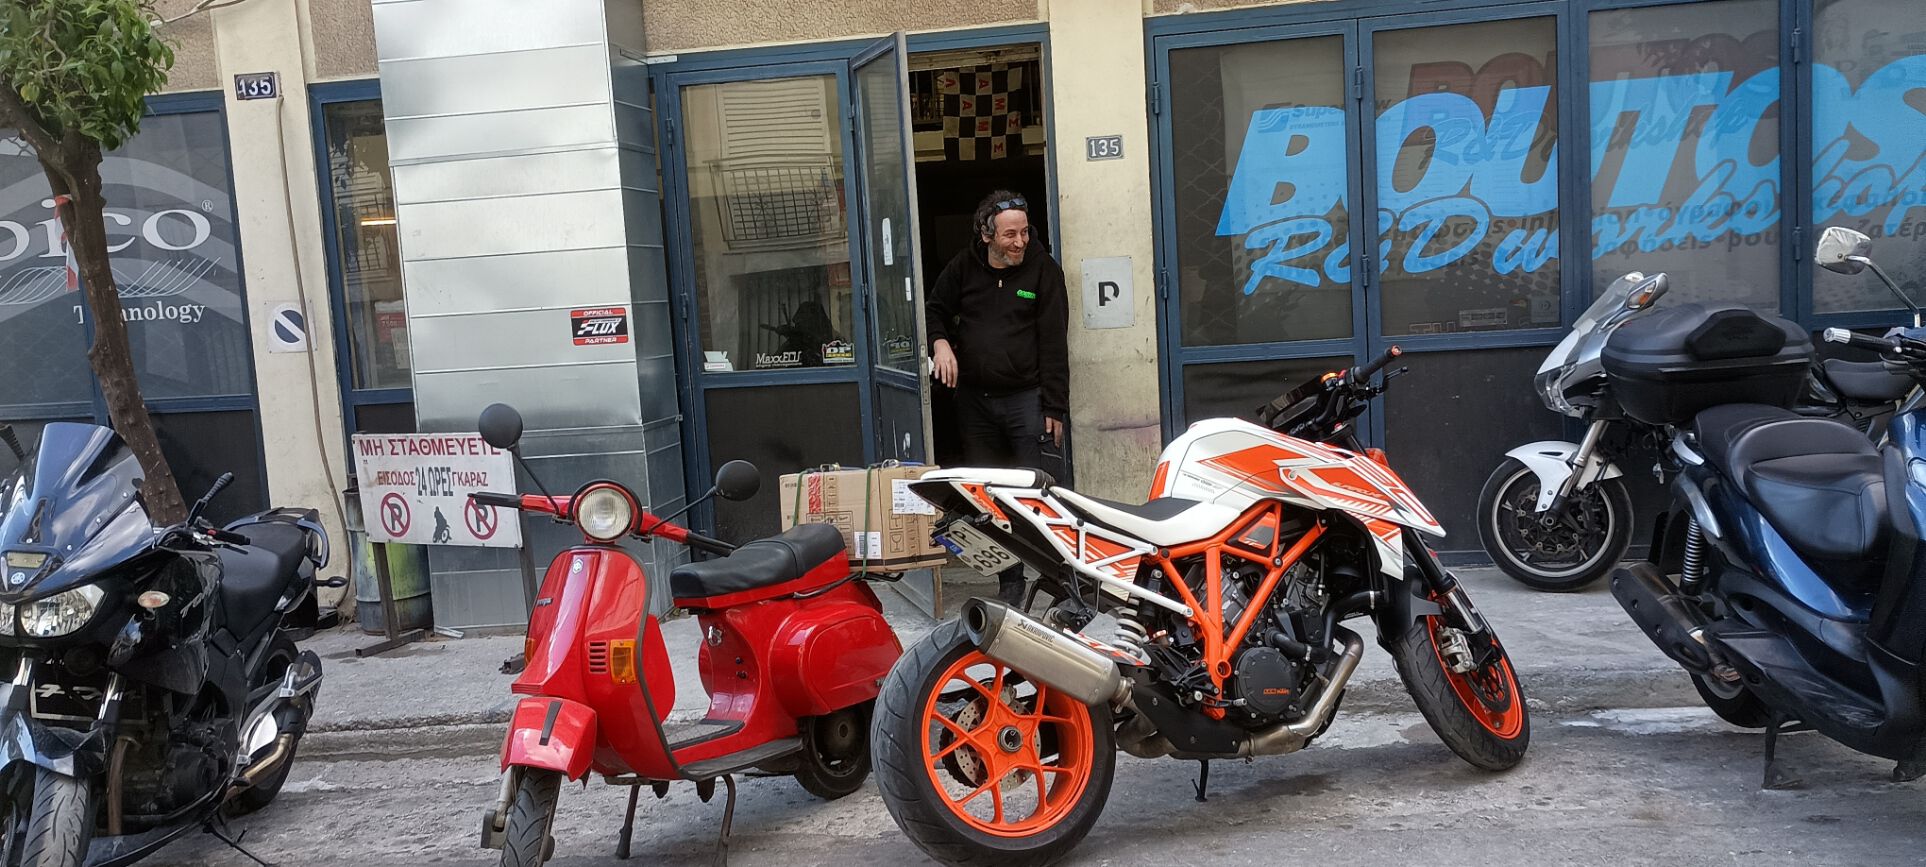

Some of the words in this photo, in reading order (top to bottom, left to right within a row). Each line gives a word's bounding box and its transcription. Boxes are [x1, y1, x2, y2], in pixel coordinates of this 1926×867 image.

[238, 76, 271, 96] 135
[1090, 139, 1119, 156] 135
[73, 300, 205, 324] Tnology
[577, 318, 622, 335] FLUX
[756, 351, 802, 364] MaxxECU
[359, 439, 385, 456] ΜΗ
[377, 471, 416, 486] ΕΙΣΟΔΟΣ
[415, 467, 427, 497] 24
[452, 471, 489, 487] ΓΚΑΡΑΖ
[973, 545, 1010, 568] 696
